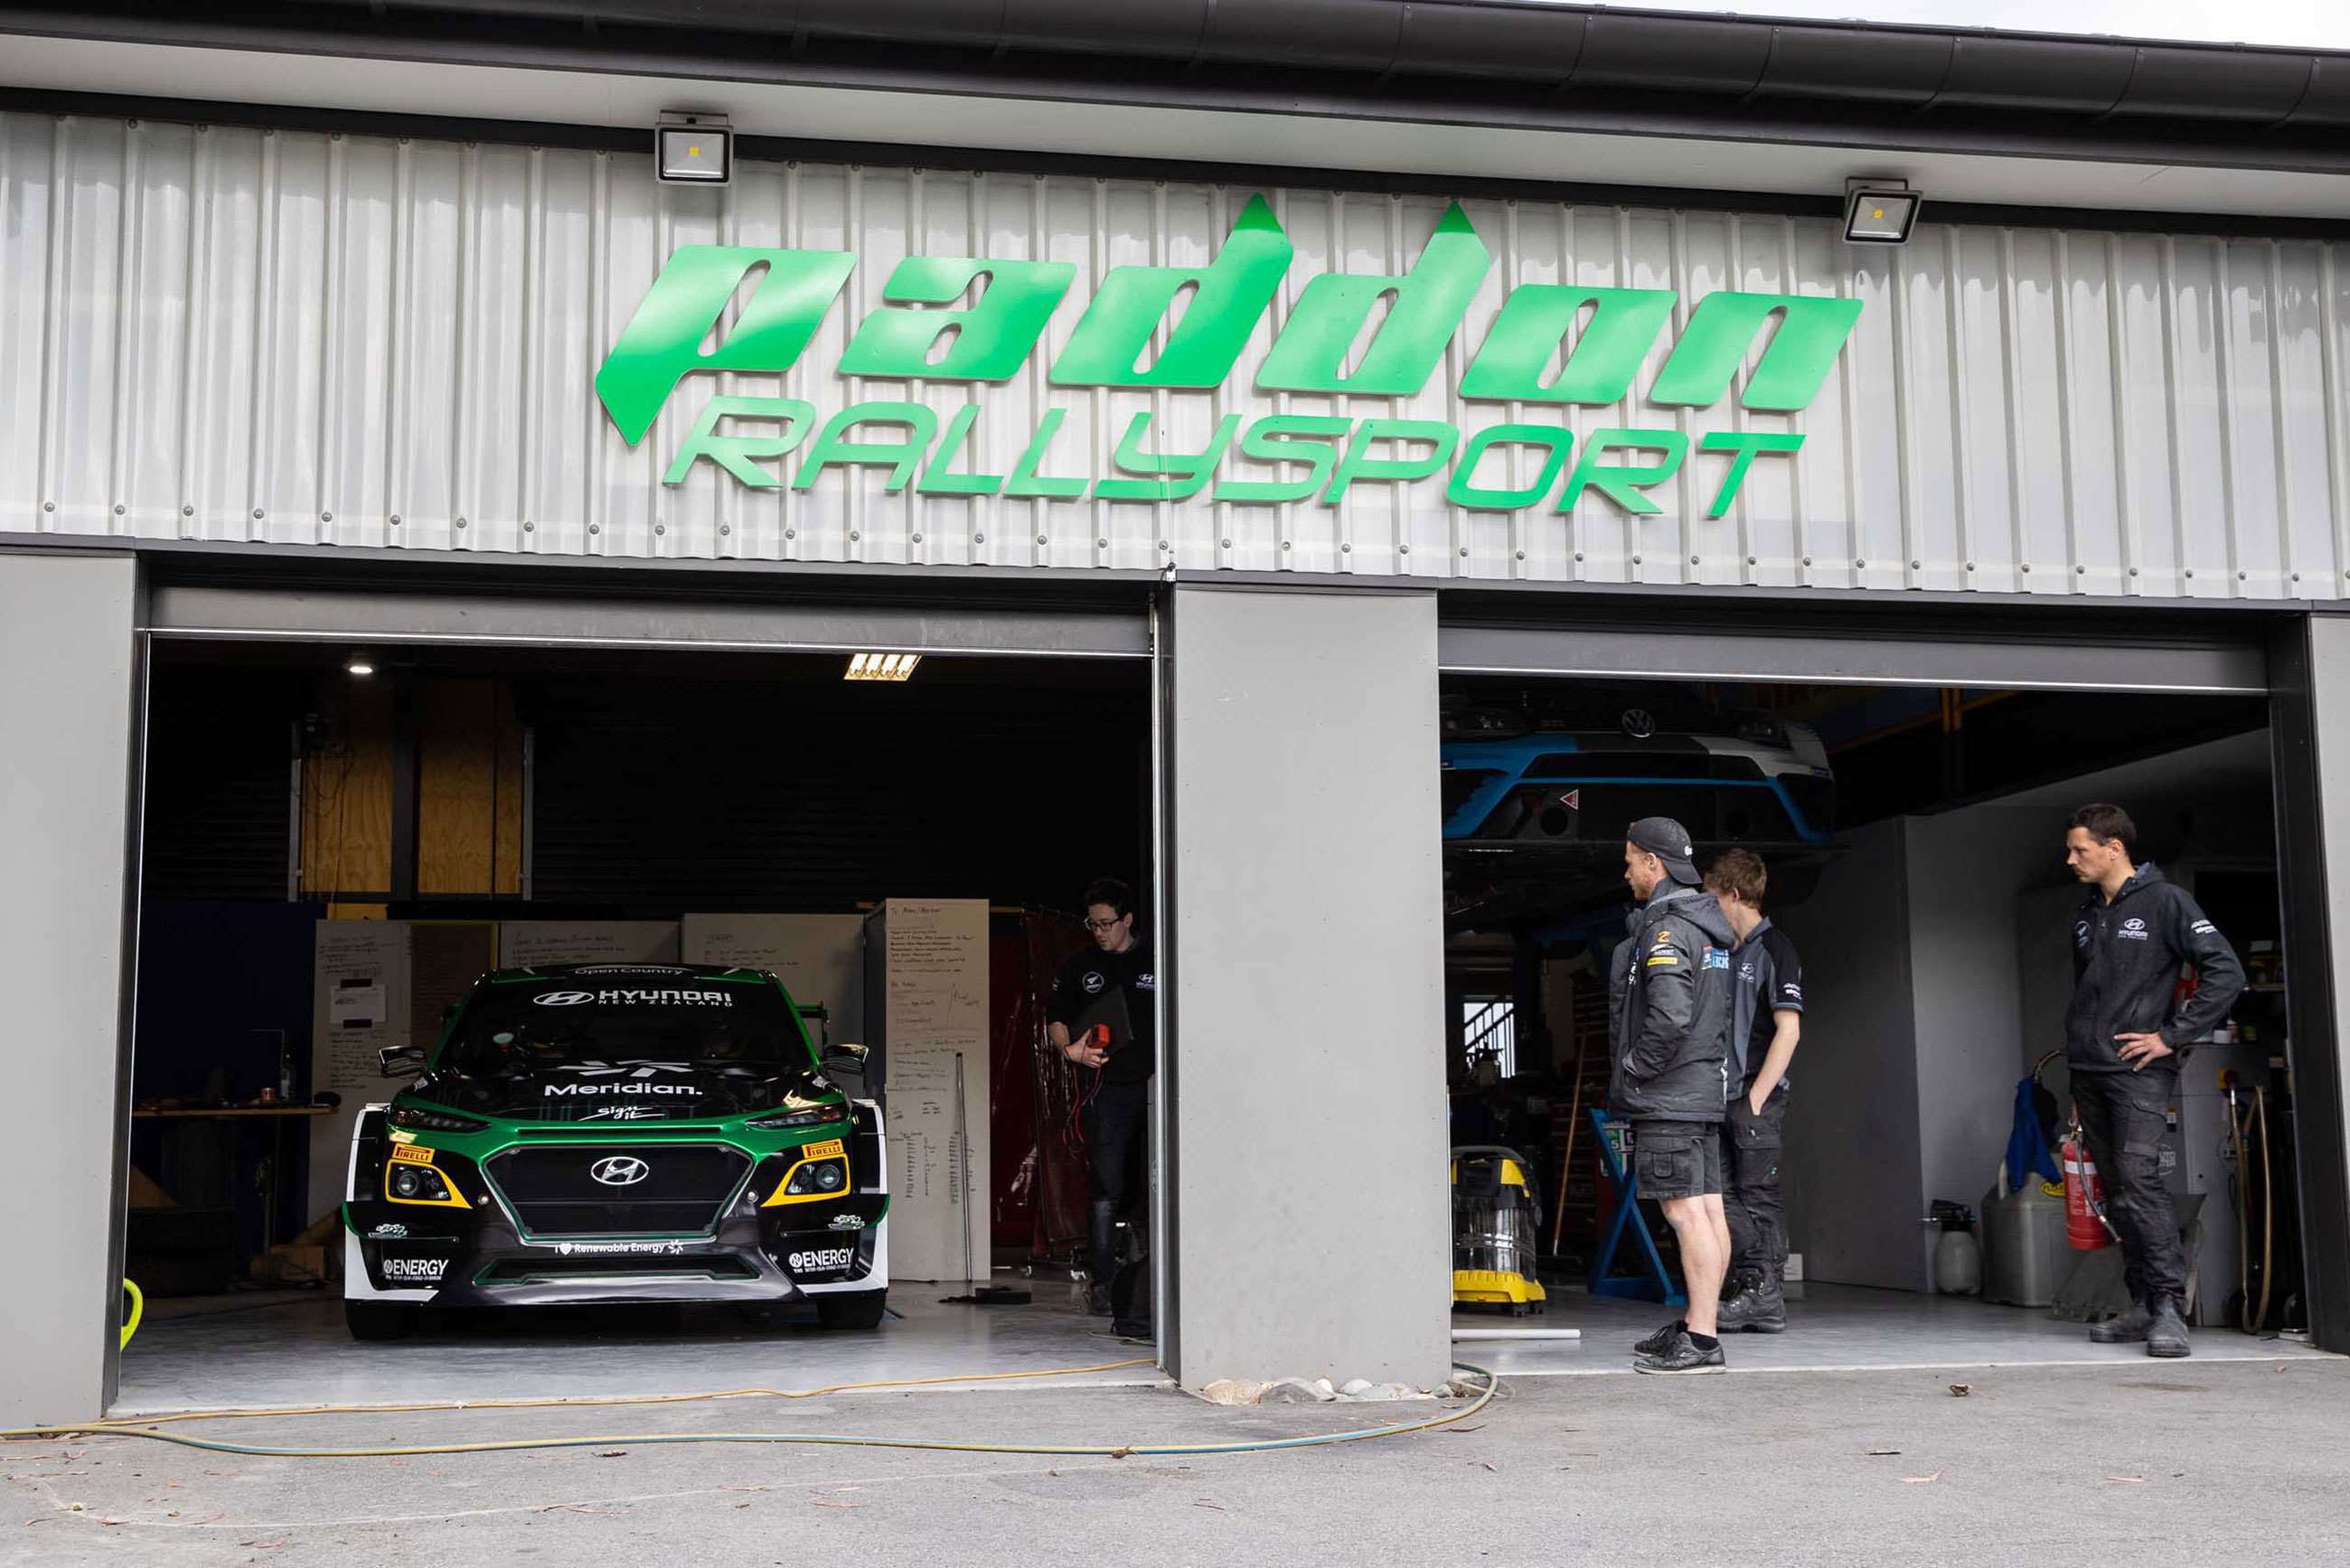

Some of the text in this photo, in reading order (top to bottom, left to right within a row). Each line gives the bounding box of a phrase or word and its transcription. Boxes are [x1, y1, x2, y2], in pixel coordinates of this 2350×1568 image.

[595, 192, 1864, 449] paddon
[599, 991, 731, 1001] HYUNDAI
[544, 1083, 703, 1096] Meridian.
[396, 1146, 431, 1160] PIRELLI
[805, 1141, 841, 1157] PIRELLI
[574, 1244, 628, 1253] Renewable
[631, 1242, 664, 1253] Energy
[802, 1247, 854, 1267] ENERGY
[393, 1259, 449, 1275] ENERGY
